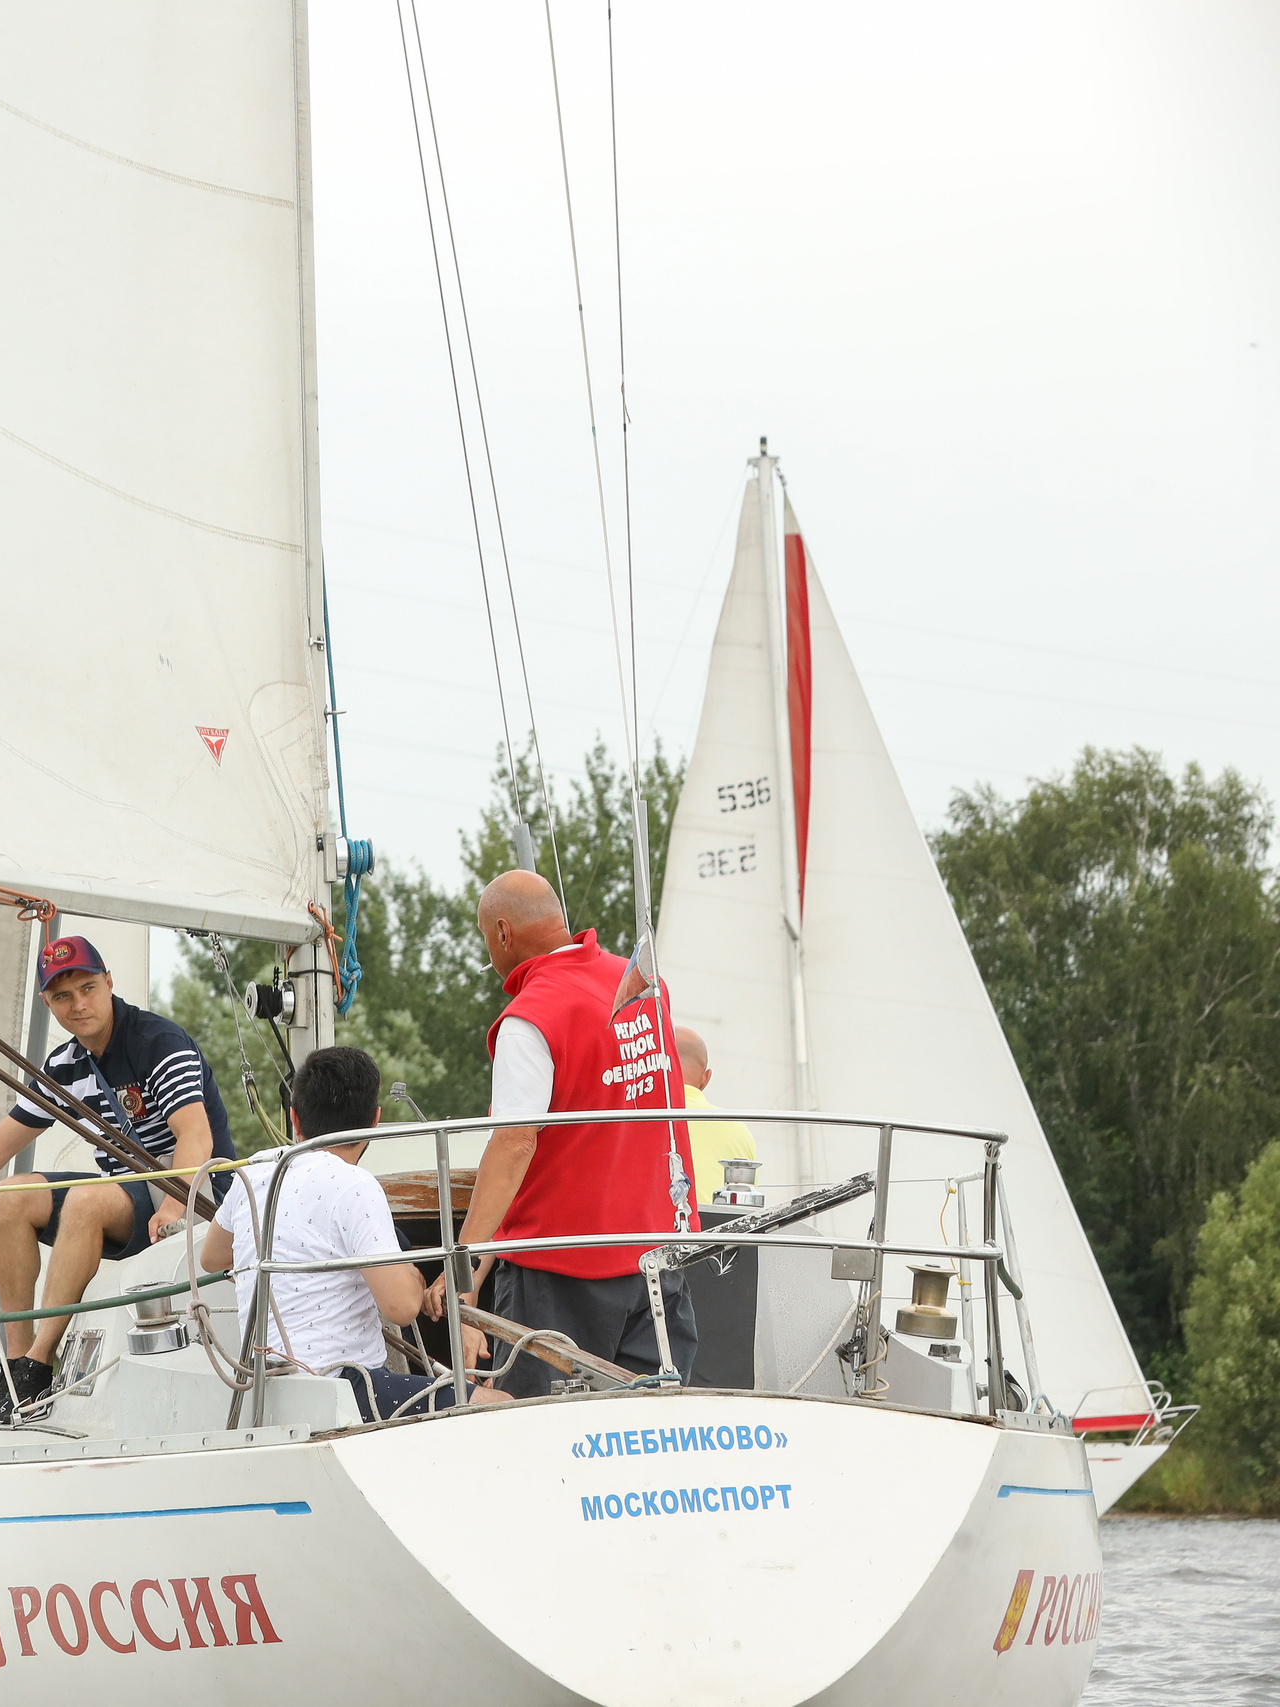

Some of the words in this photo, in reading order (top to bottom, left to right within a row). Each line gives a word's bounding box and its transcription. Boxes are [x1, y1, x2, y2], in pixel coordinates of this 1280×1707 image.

[718, 776, 771, 813] 536
[613, 1013, 653, 1040] РЕГАТА
[619, 1033, 657, 1061] КУБОК
[625, 1075, 654, 1101] 2013
[571, 1425, 788, 1458] «ХЛЕБНИКОВО»
[581, 1484, 792, 1521] МОСКОМСПОРТ
[7, 1573, 283, 1657] РОССИЯ
